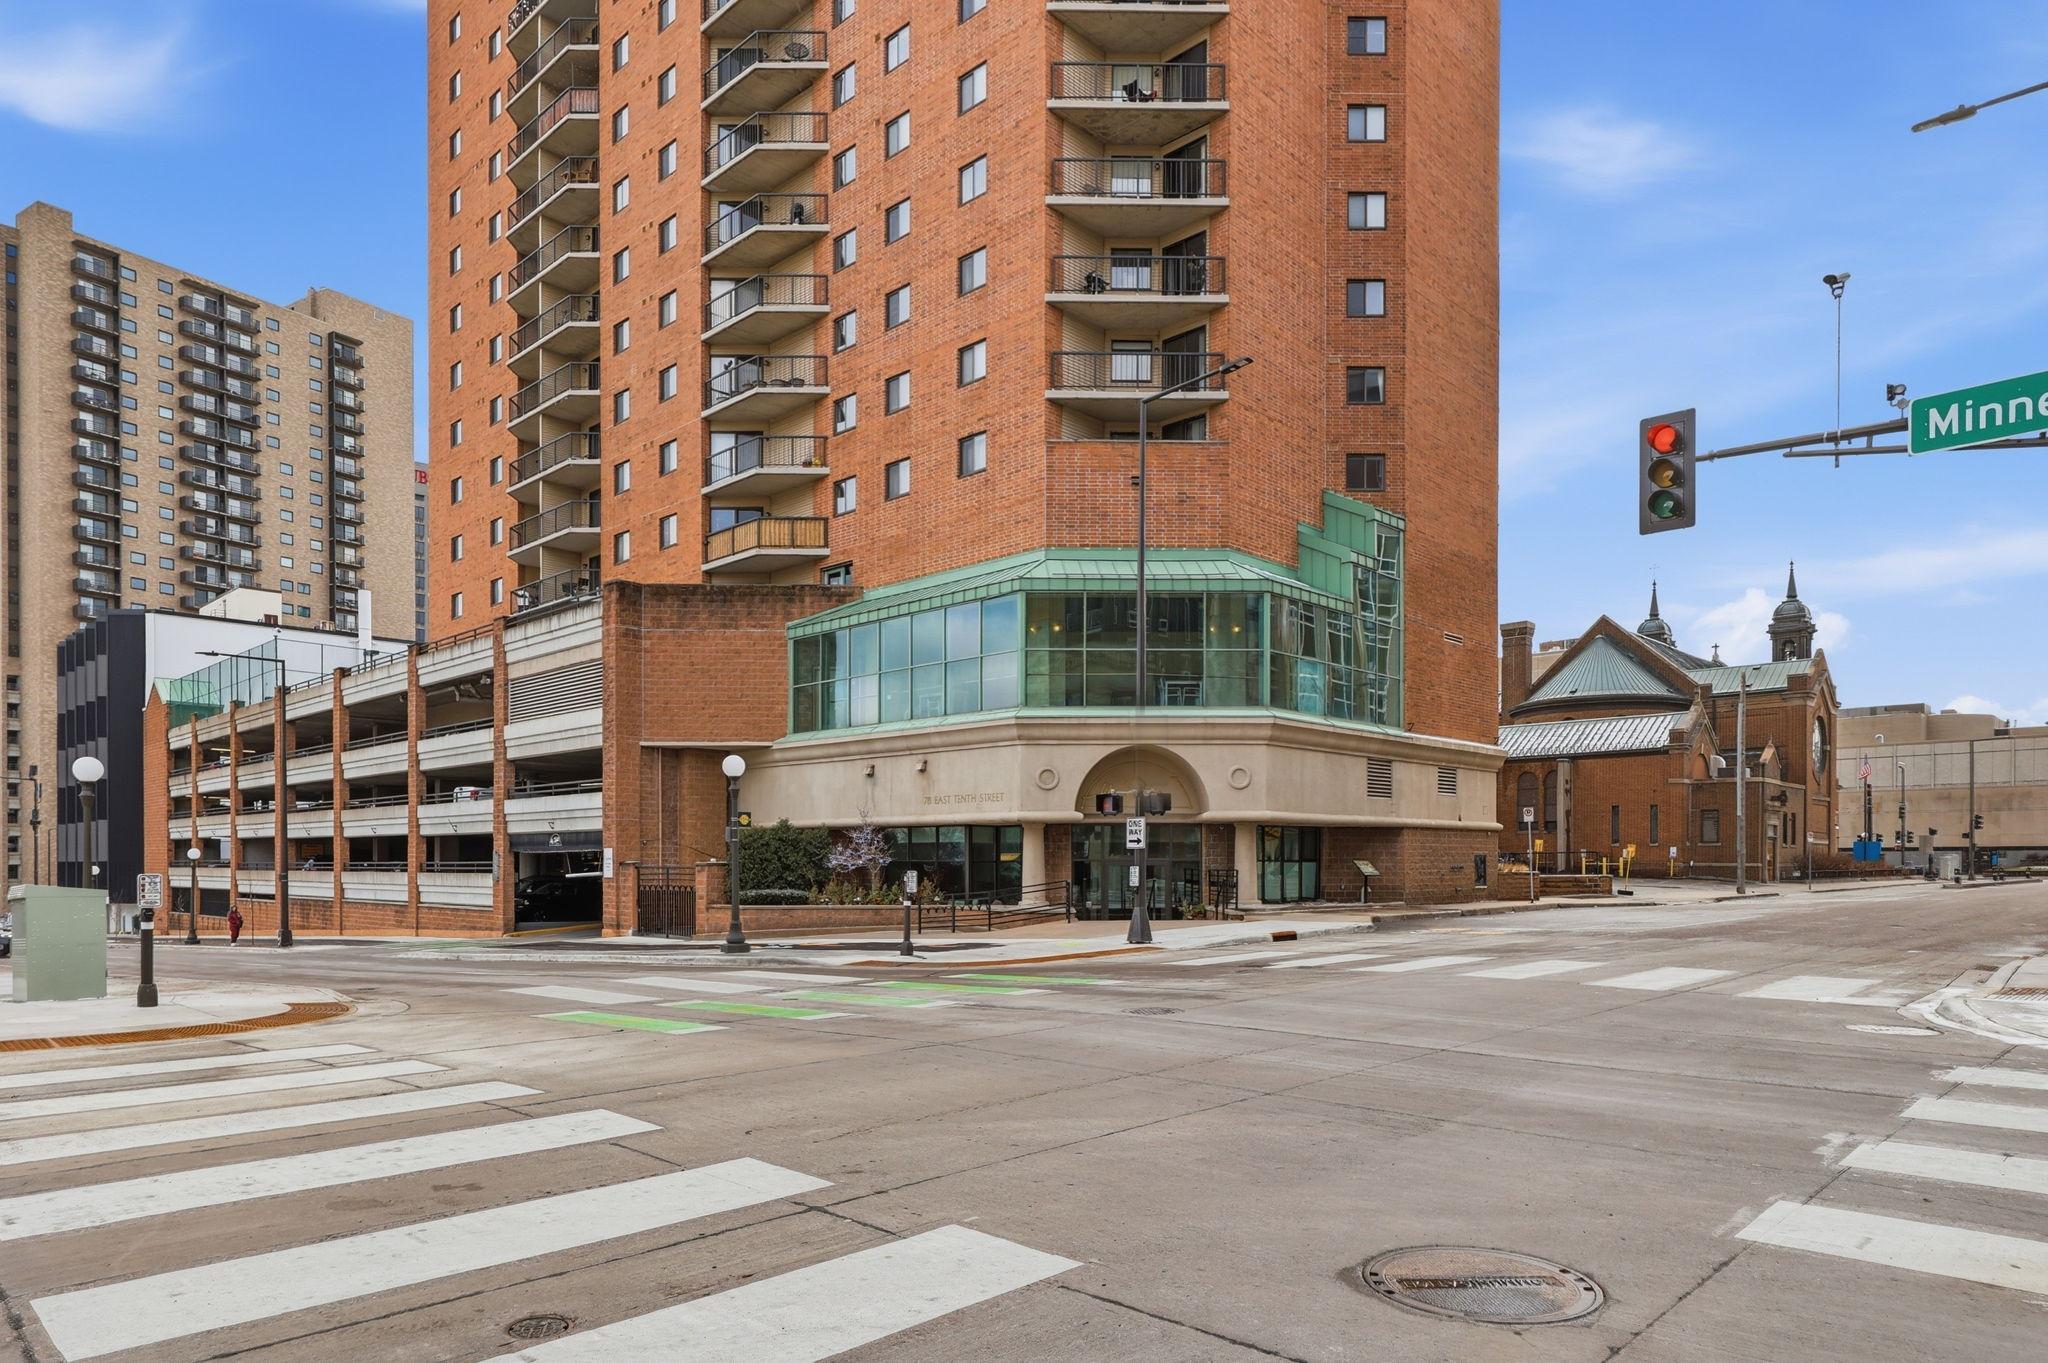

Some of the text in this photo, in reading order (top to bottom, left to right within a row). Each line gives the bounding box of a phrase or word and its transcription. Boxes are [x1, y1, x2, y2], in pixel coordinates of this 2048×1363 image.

[934, 795, 951, 805] EAST
[954, 794, 976, 804] TENTH
[979, 792, 1004, 803] STREET
[1128, 820, 1142, 828] ONE
